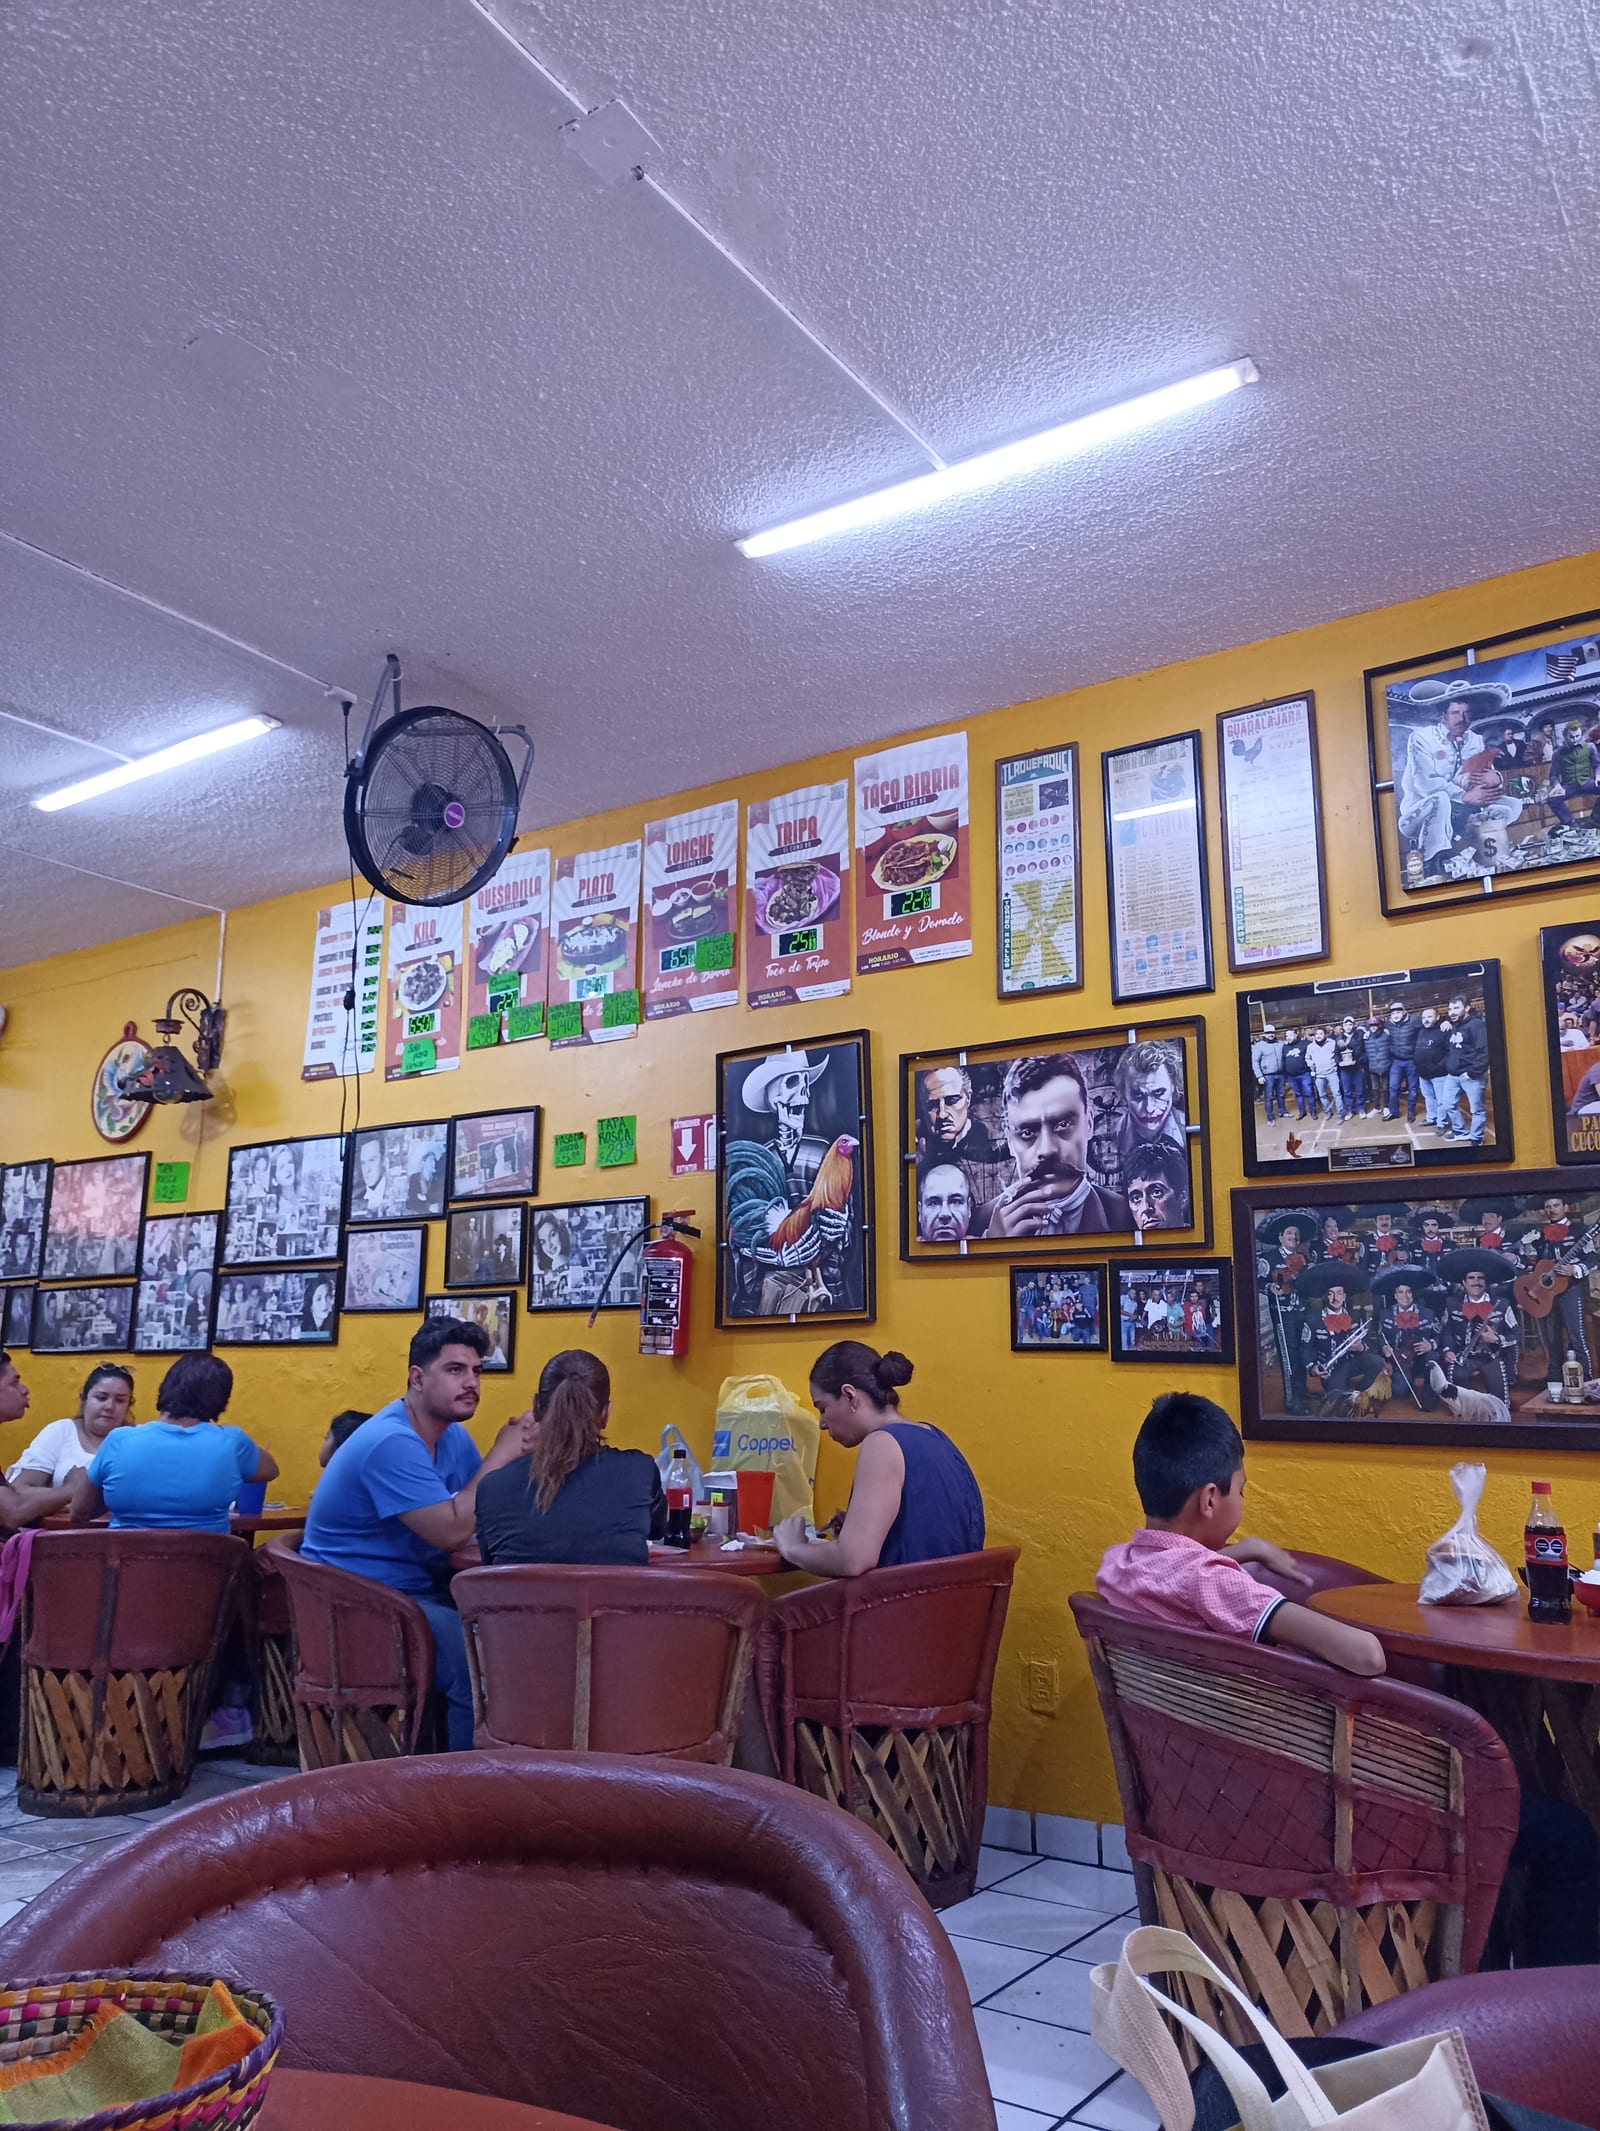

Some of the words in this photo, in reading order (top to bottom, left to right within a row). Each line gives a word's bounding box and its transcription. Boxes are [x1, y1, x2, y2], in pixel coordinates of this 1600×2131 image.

[1227, 709, 1302, 738] GUADALAJARA
[862, 778, 900, 811] TACO
[904, 764, 960, 800] BIRRIA
[776, 815, 818, 847] TRIPA
[666, 832, 714, 866] LONCHE
[477, 875, 542, 910] QUESADILLA
[578, 872, 614, 900] PLATO
[414, 919, 436, 943] KILO
[902, 925, 912, 940] y
[918, 912, 964, 933] Dorado
[788, 960, 802, 973] de
[868, 952, 899, 964] HORARIO
[598, 1116, 626, 1131] TAPA
[1582, 1116, 1600, 1130] PA
[598, 1128, 632, 1145] ROSCA
[737, 1434, 797, 1456] Coppel
